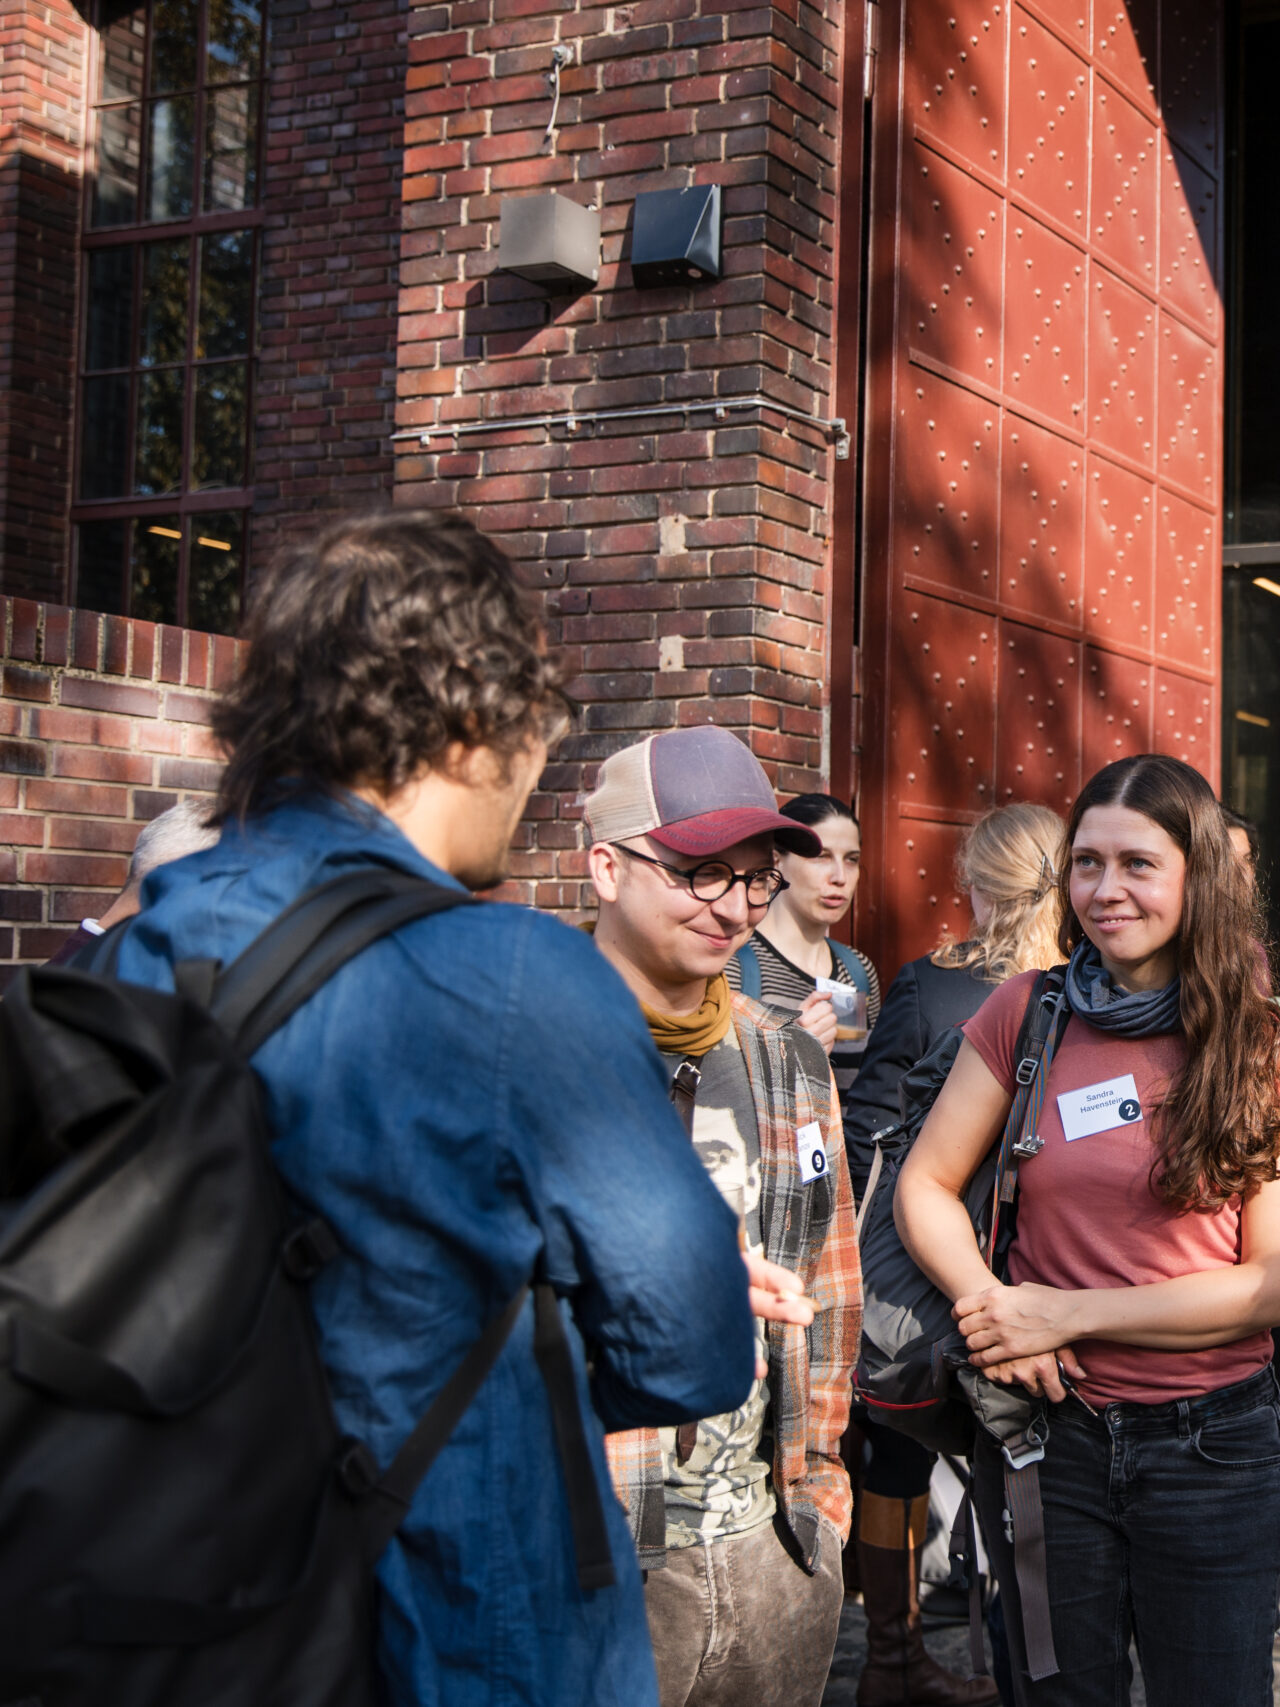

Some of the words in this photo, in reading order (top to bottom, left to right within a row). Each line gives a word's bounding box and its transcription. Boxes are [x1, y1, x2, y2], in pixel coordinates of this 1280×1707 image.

[1086, 1089, 1114, 1102] Sandra
[1080, 1097, 1124, 1113] Havenstein
[1125, 1103, 1136, 1117] 2
